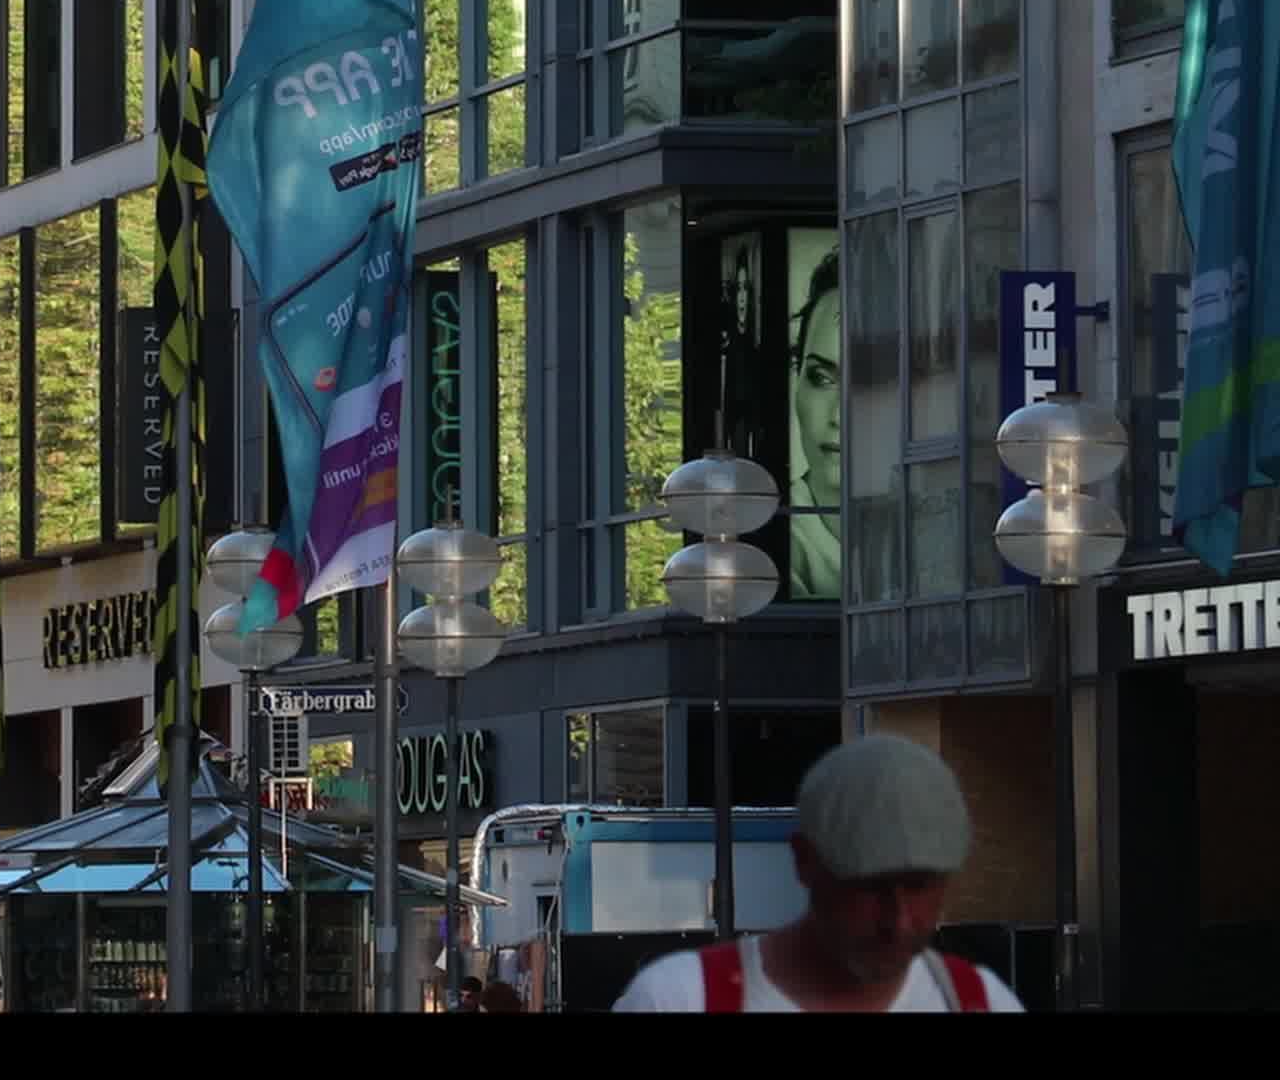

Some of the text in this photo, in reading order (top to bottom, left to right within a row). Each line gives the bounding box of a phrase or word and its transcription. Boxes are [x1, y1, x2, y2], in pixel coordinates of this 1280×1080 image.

[143, 324, 163, 505] RESERVED
[270, 688, 377, 714] Färbergrab
[396, 728, 485, 816] OUGAS
